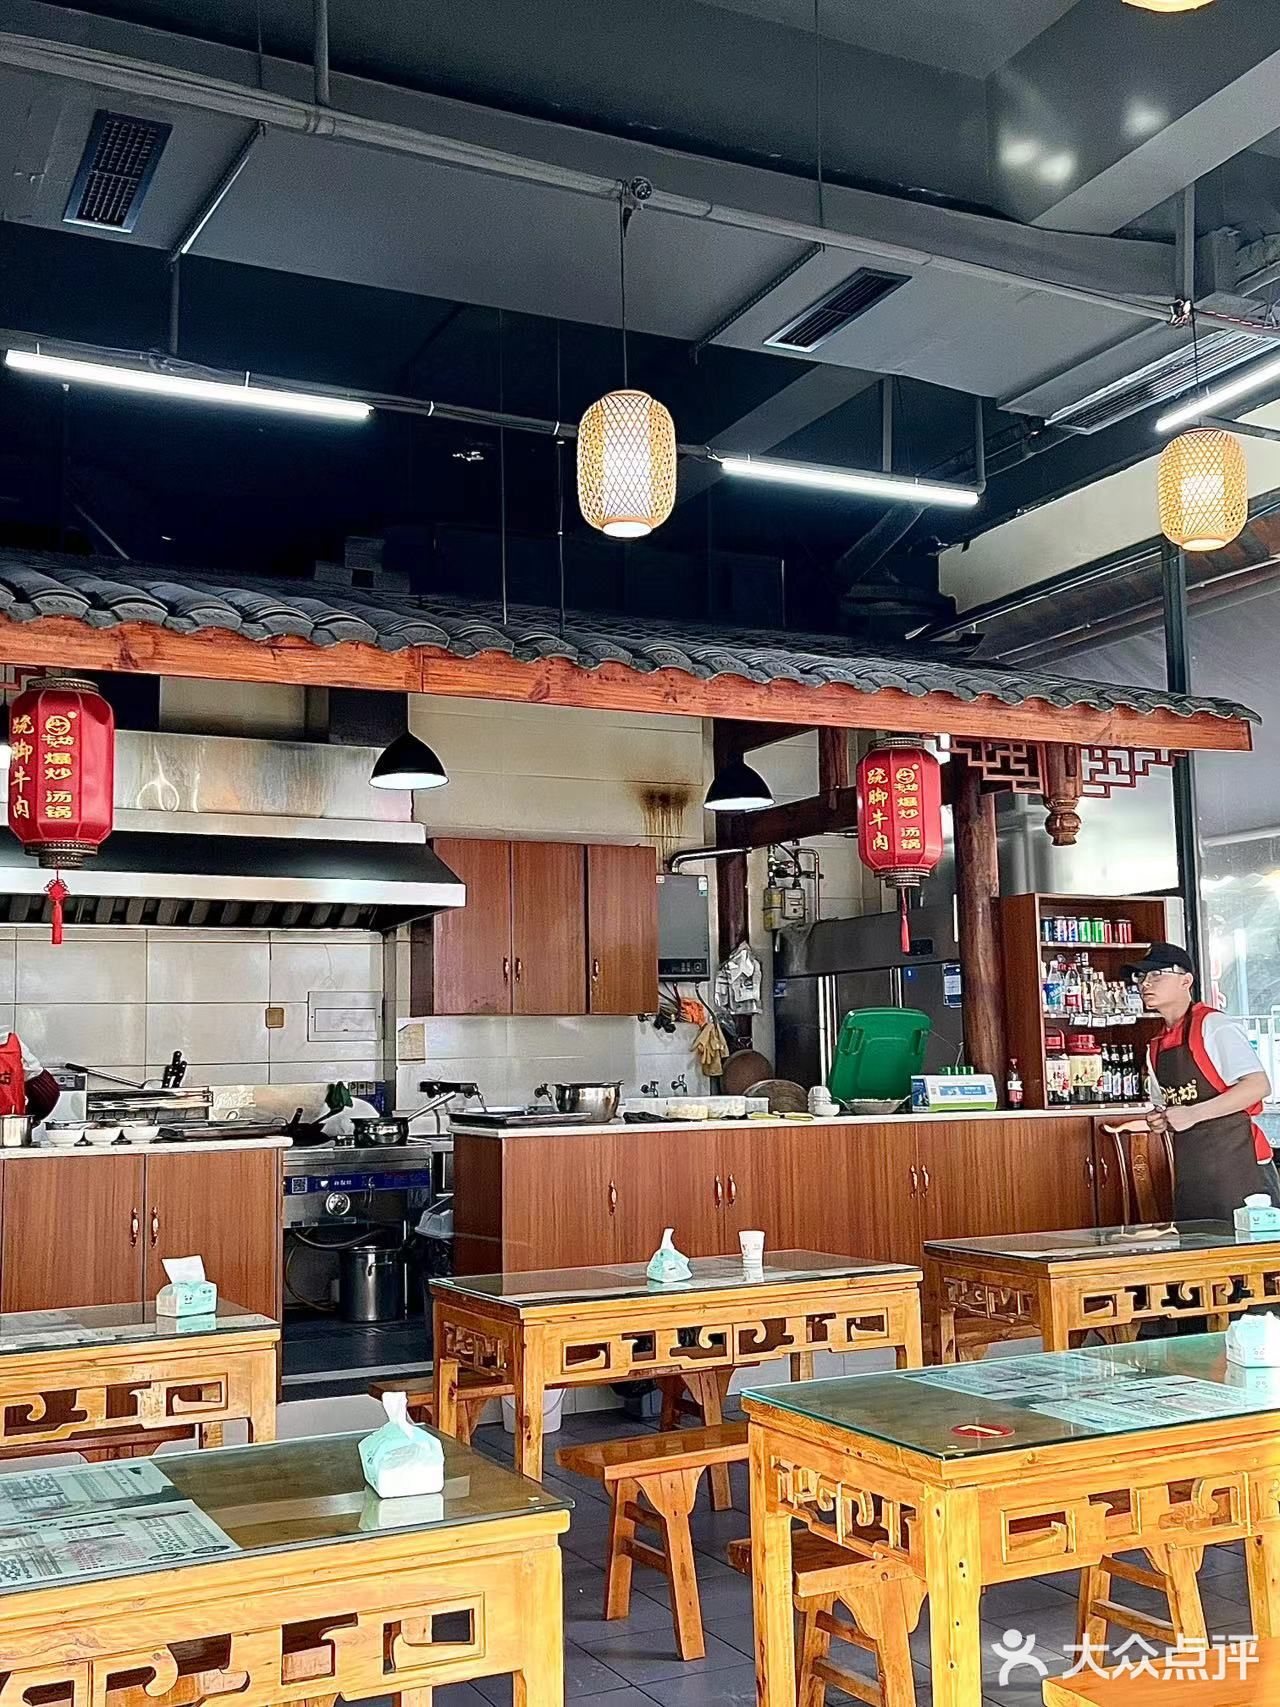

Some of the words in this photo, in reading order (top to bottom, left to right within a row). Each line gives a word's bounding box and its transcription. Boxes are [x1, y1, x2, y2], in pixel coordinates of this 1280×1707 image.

[10, 714, 35, 819] 跷脚牛肉
[44, 790, 72, 819] 汤锅
[868, 768, 888, 851] 跷脚牛肉
